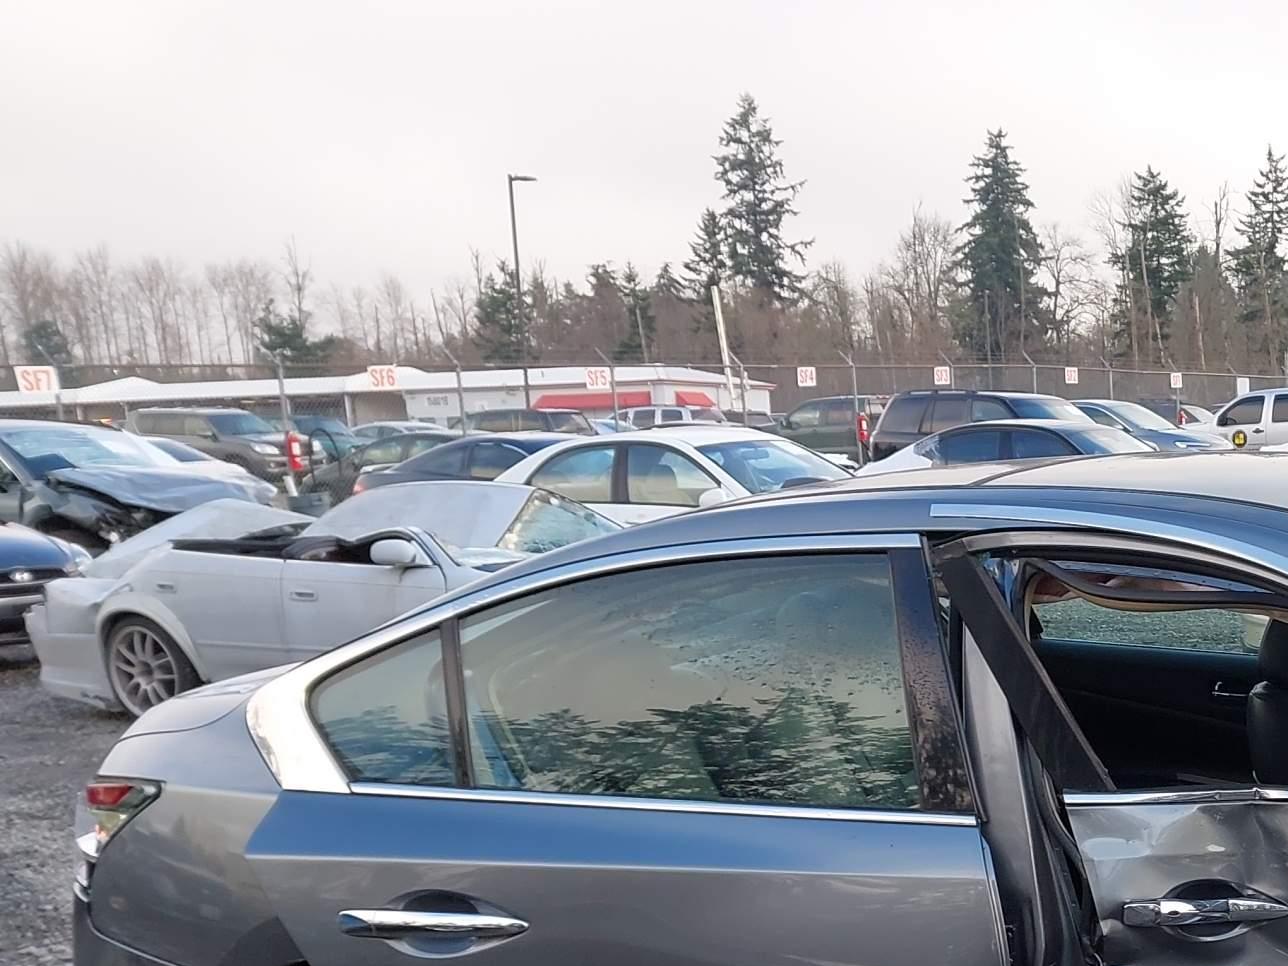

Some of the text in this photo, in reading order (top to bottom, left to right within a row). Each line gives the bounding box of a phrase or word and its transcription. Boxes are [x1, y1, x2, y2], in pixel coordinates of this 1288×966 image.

[21, 369, 51, 391] SF7
[370, 368, 395, 387] SF6
[587, 369, 607, 386] SF5
[799, 368, 814, 384] SF4
